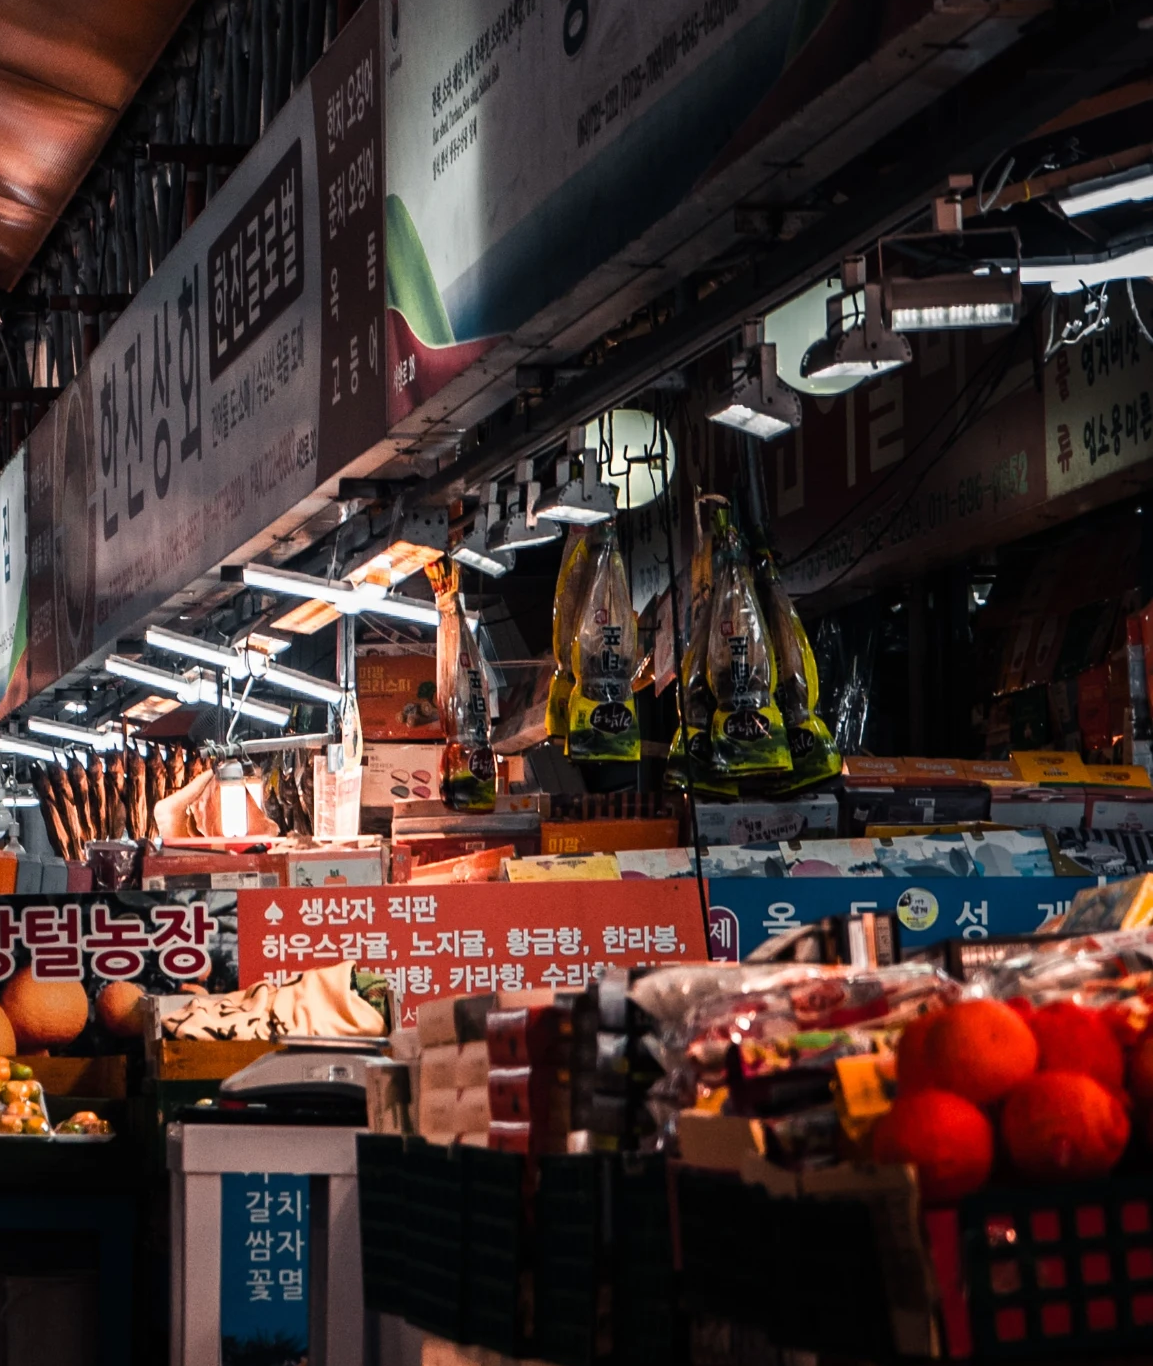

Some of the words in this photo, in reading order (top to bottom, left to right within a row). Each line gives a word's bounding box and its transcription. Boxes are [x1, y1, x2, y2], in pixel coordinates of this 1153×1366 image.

[327, 83, 346, 154] 한치
[347, 48, 373, 130] 오징어
[348, 138, 375, 216] 오징어
[213, 167, 297, 358] 한진글로벌
[1081, 320, 1140, 386] 영지버섯
[100, 263, 203, 542] 한진상회
[548, 836, 580, 852] 미깡
[261, 932, 397, 961] 하우스감귤,
[409, 929, 494, 959] 노지귤,
[506, 927, 588, 957] 황금향,
[602, 924, 686, 954] 한라봉,
[299, 897, 375, 926] 생산자
[387, 895, 438, 923] 직판
[449, 964, 533, 993] 카라향,
